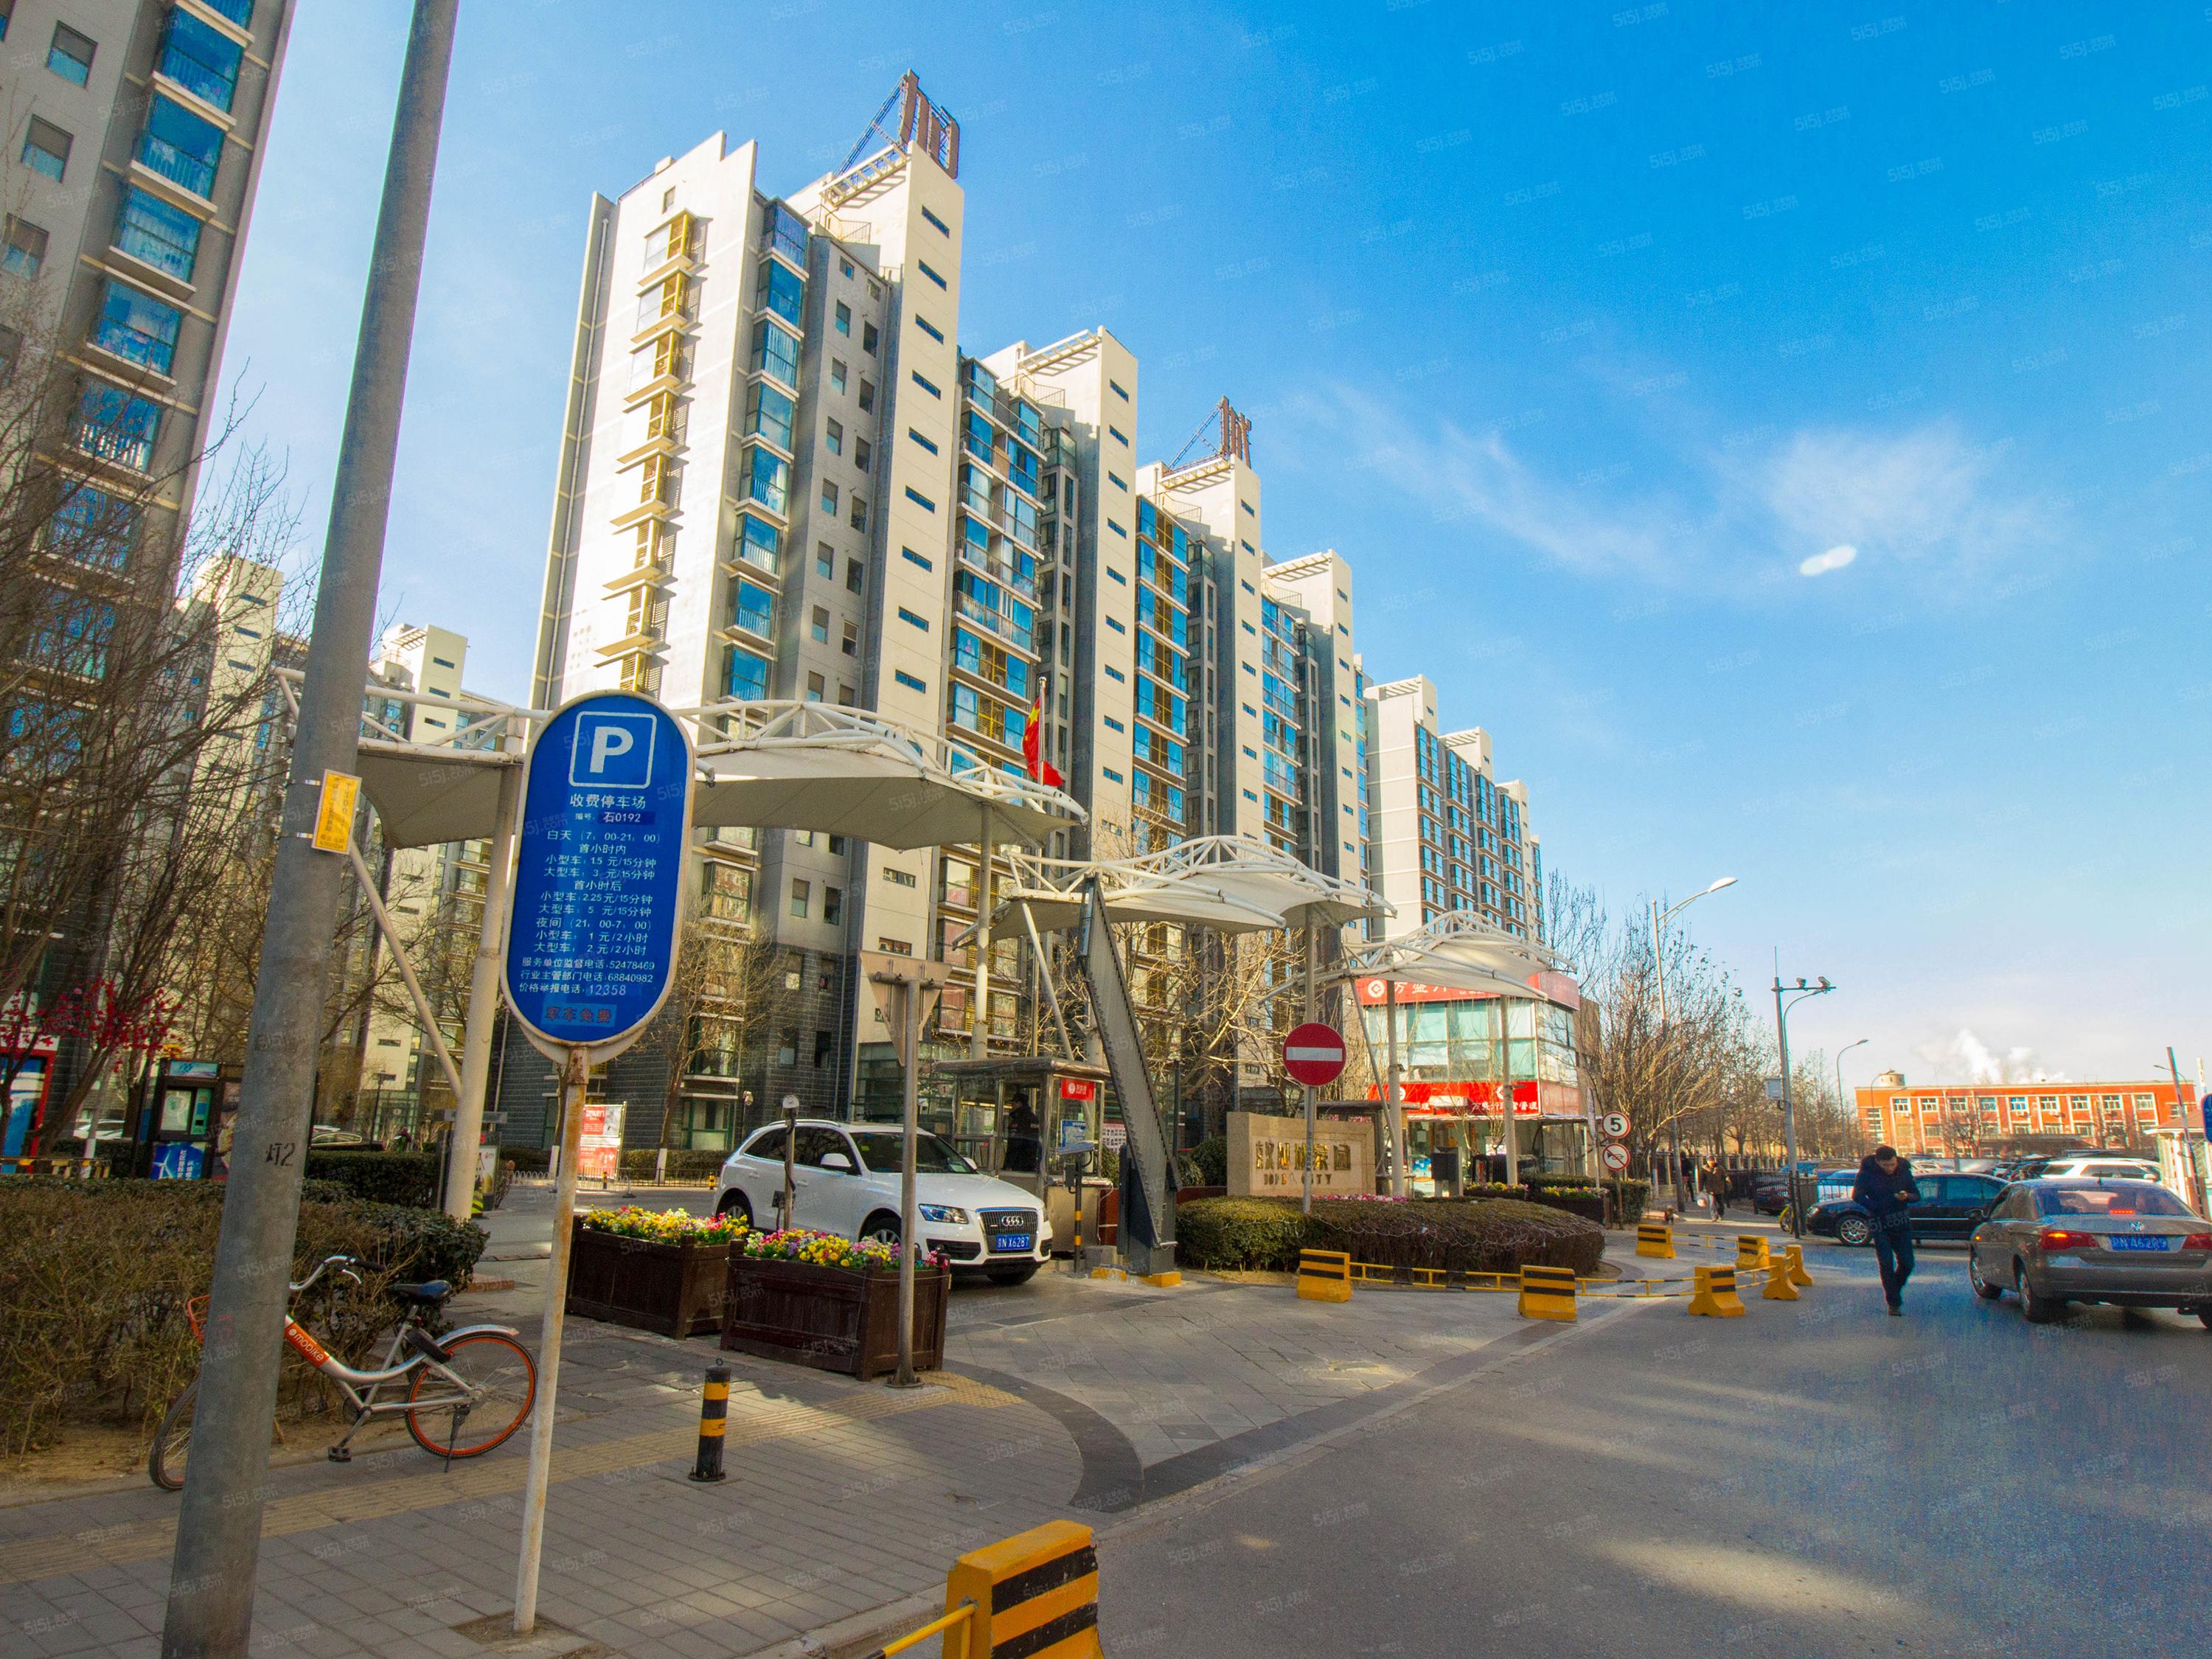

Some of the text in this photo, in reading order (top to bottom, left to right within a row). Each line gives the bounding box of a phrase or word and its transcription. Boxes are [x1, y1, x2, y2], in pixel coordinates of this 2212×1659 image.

[590, 726, 633, 773] P
[569, 793, 646, 809] 收费停车场
[579, 844, 626, 855] 首小时内
[574, 880, 622, 891] 首小时后
[1610, 1117, 1621, 1132] 5
[293, 1333, 324, 1361] mobike
